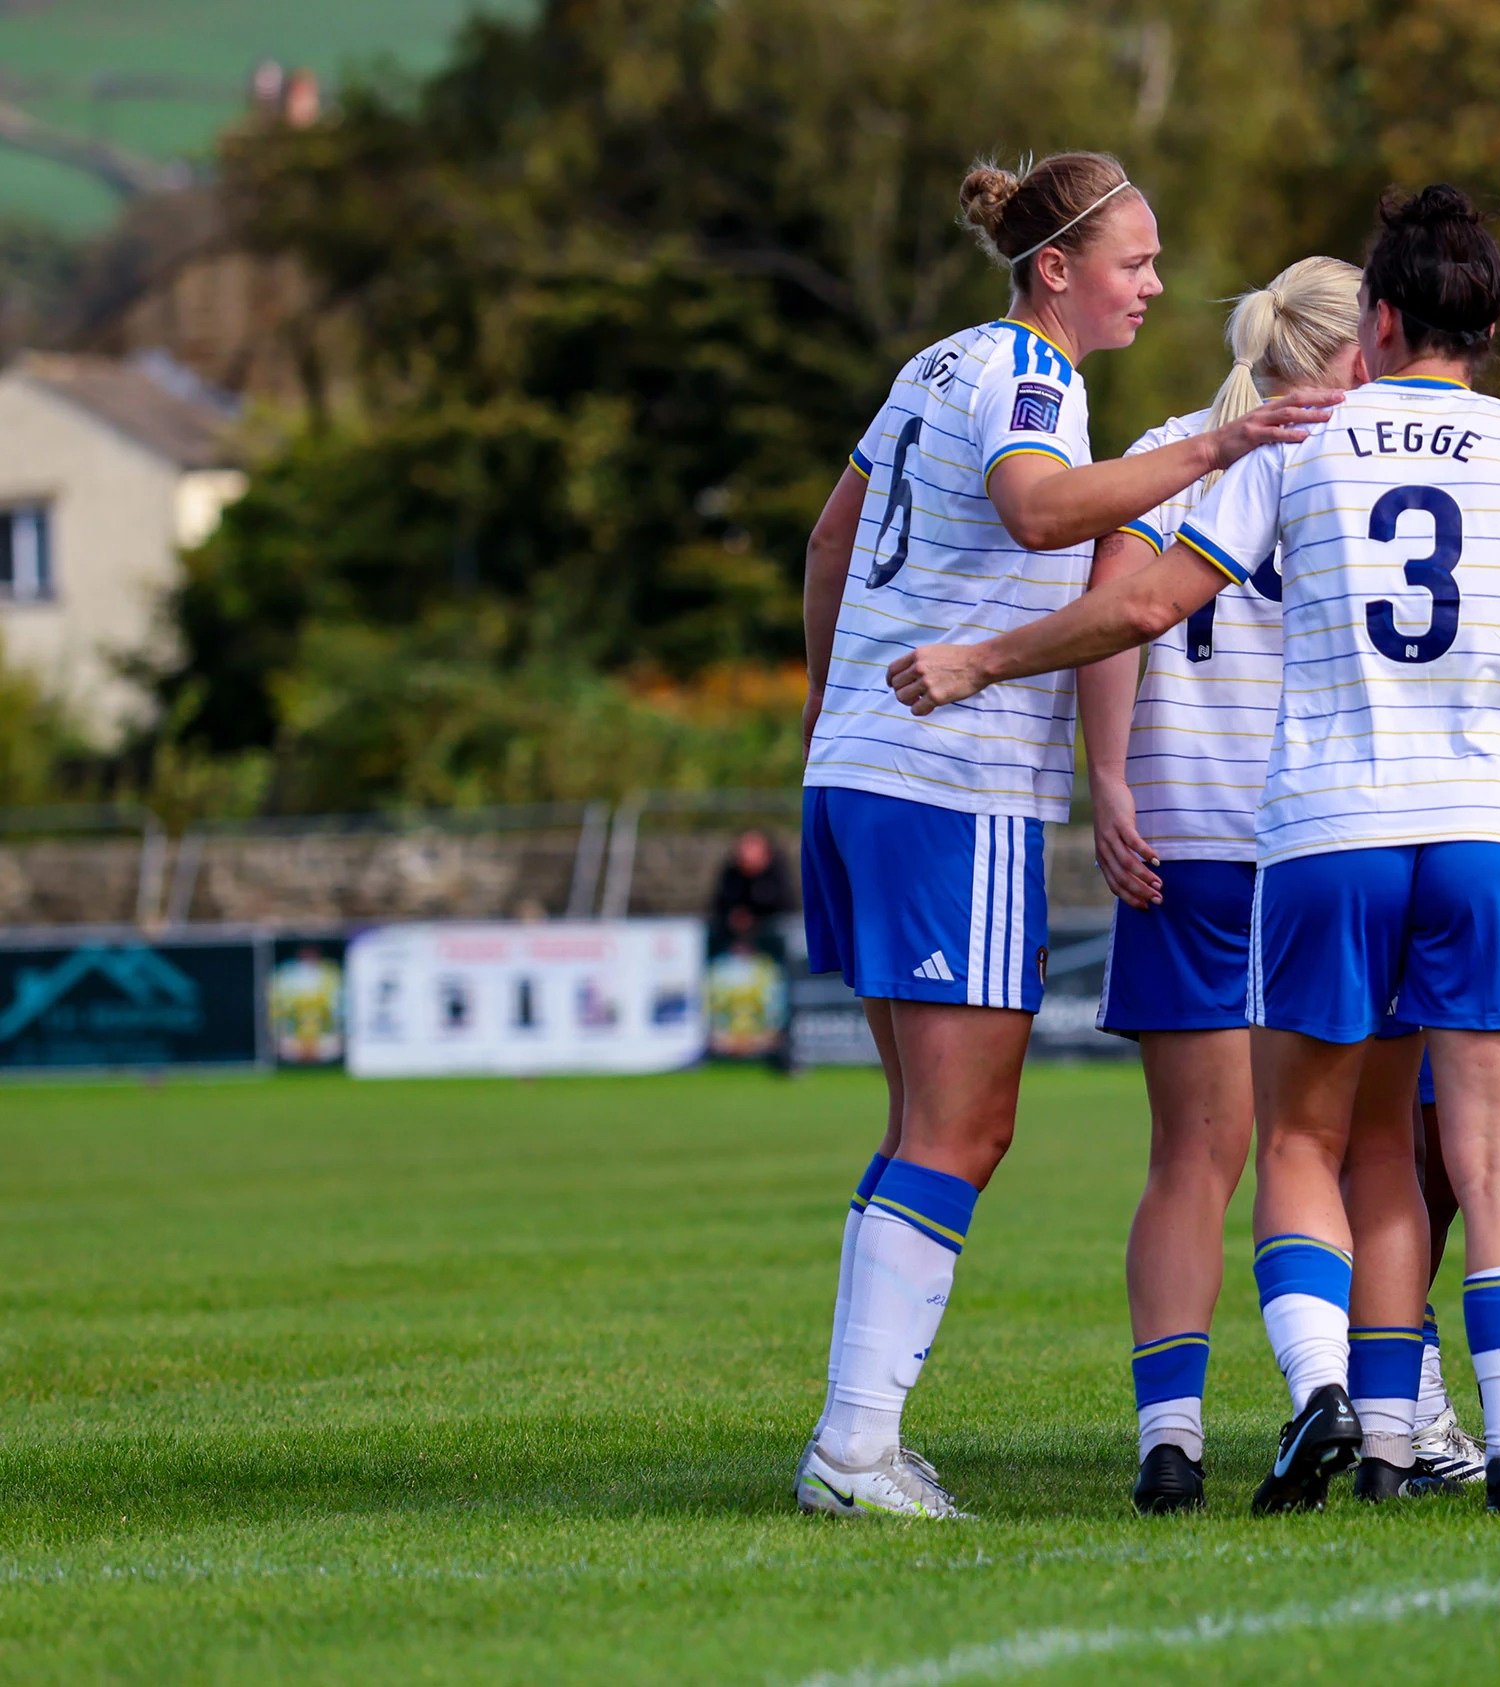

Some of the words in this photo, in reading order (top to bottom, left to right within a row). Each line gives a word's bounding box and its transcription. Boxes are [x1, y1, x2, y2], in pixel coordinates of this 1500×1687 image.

[865, 416, 923, 589] 6
[1346, 421, 1483, 463] LEGGE
[1366, 484, 1463, 663] 3
